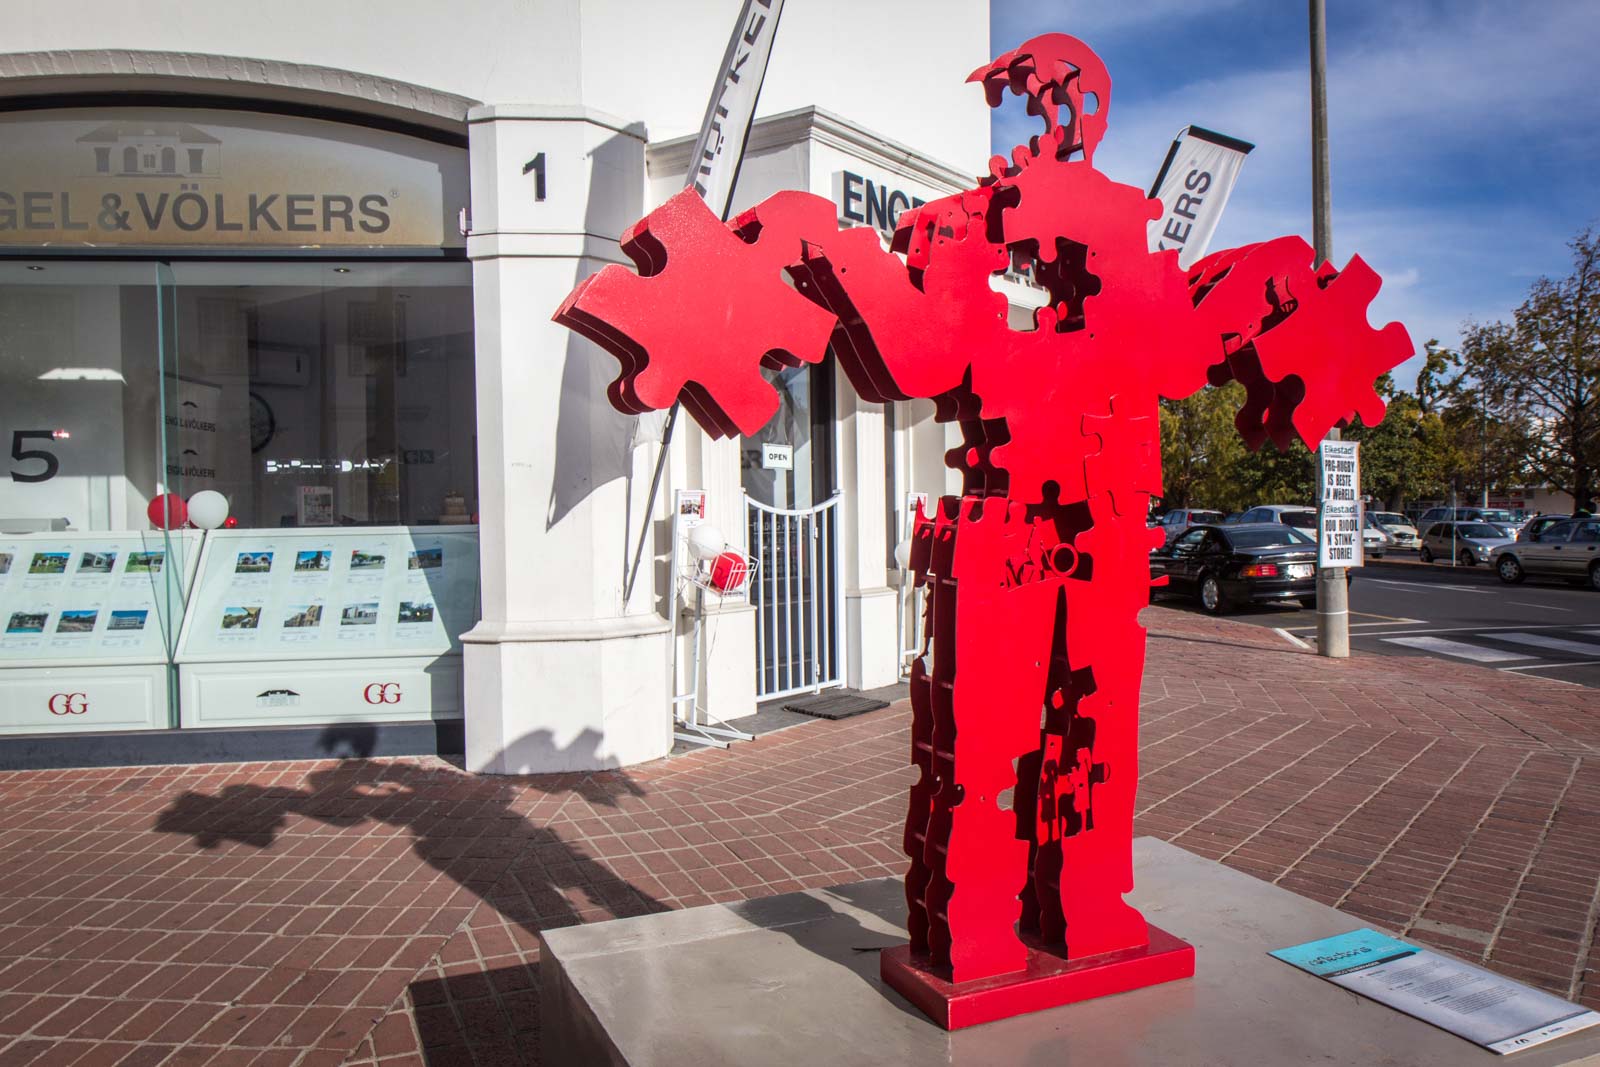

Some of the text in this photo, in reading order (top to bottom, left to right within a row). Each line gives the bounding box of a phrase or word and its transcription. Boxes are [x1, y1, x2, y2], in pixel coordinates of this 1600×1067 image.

[522, 152, 546, 202] 1
[843, 170, 927, 232] ENG
[1159, 169, 1212, 254] ERS
[10, 430, 59, 483] 5
[1327, 474, 1352, 487] IS BESTE
